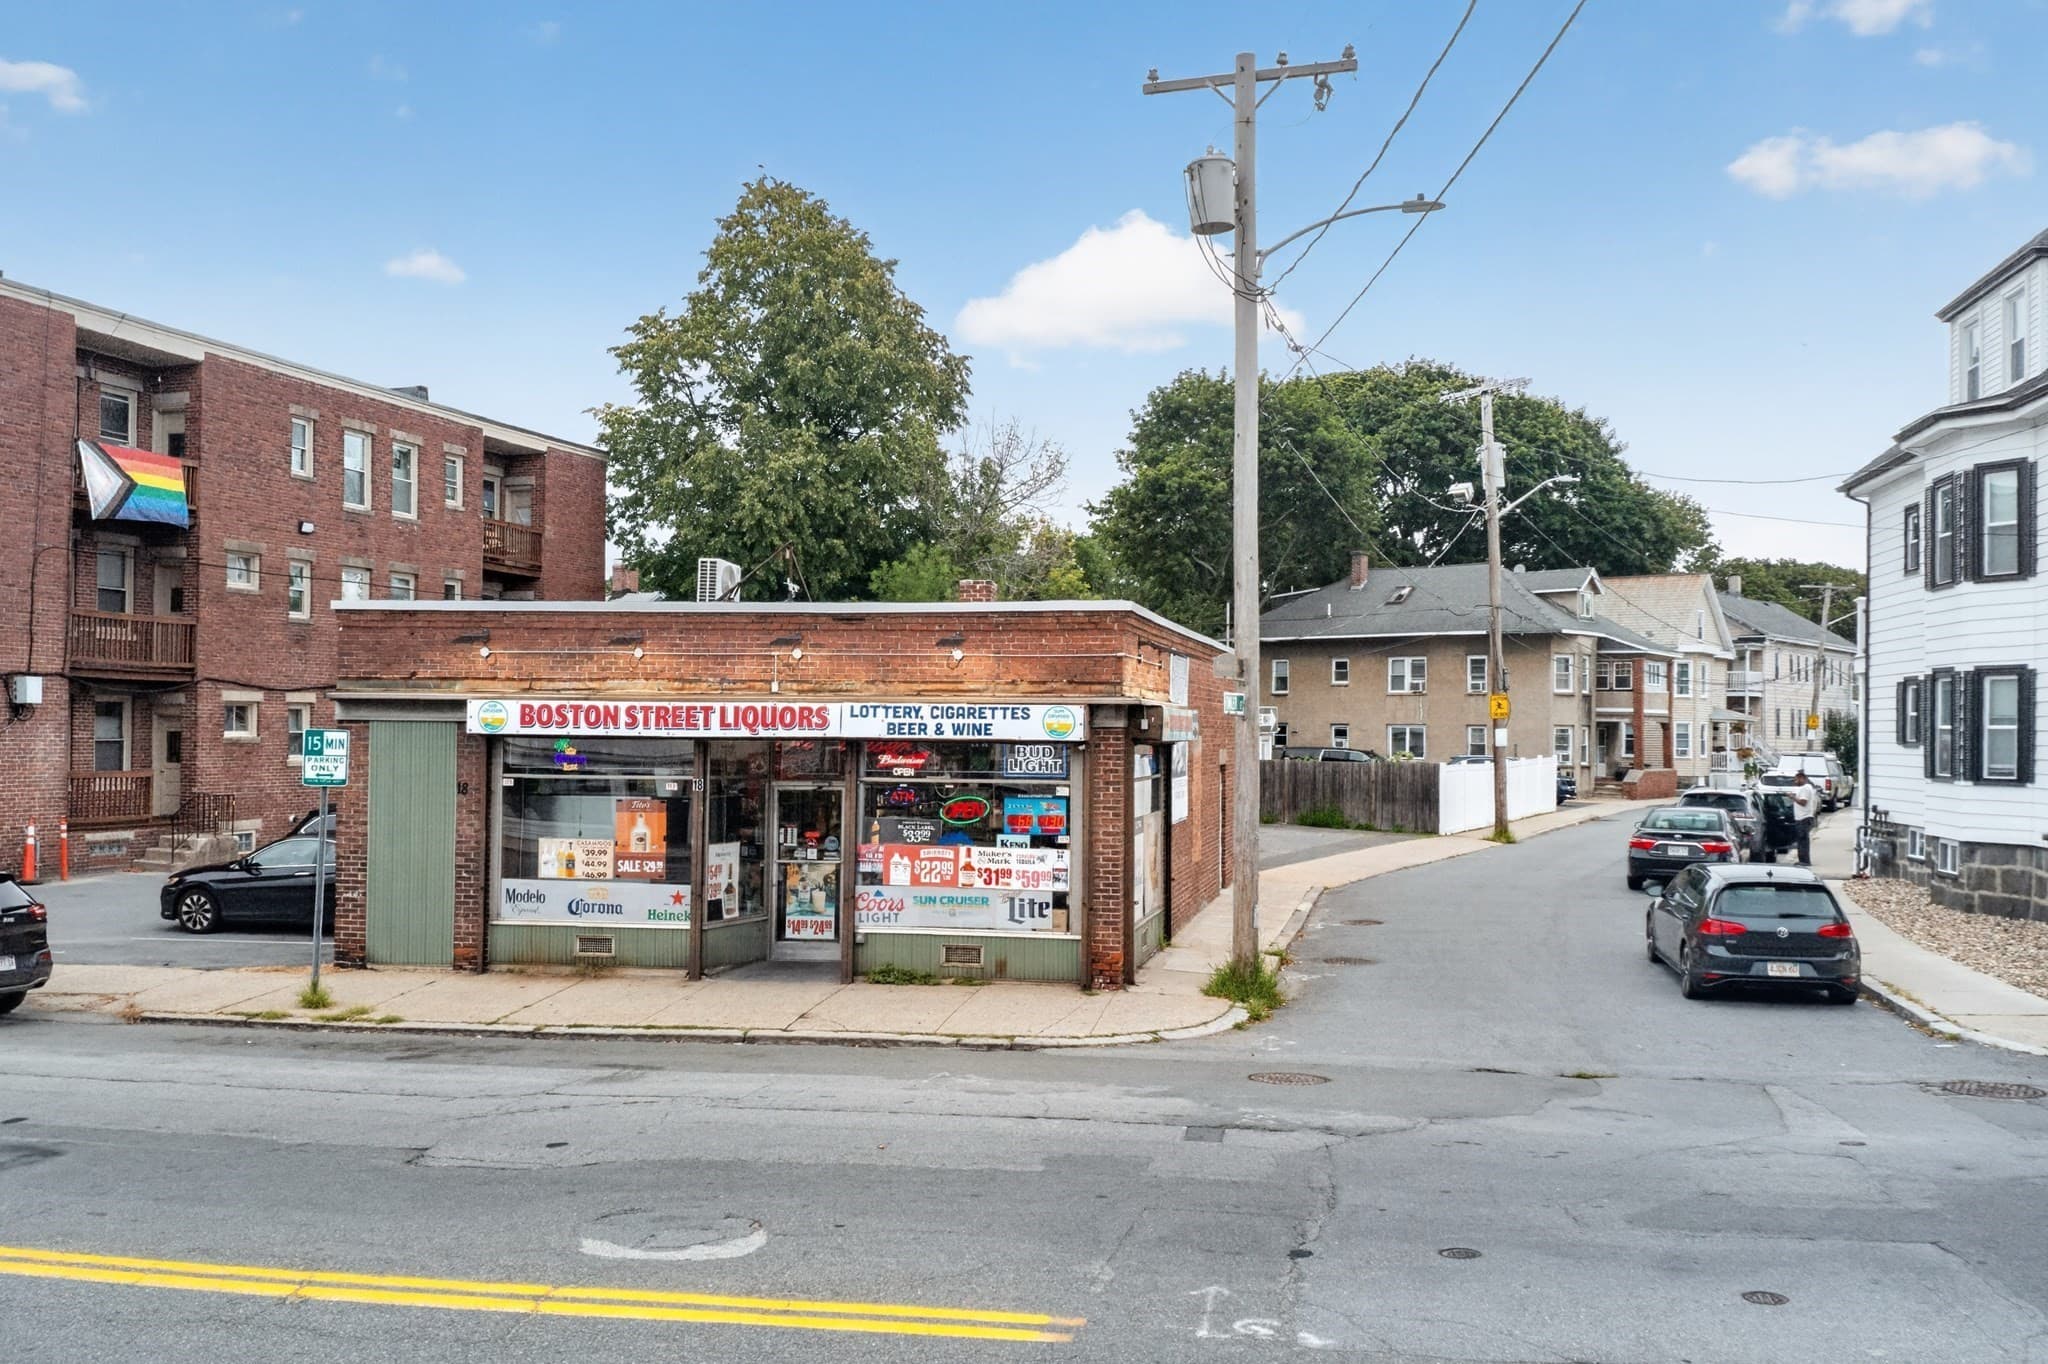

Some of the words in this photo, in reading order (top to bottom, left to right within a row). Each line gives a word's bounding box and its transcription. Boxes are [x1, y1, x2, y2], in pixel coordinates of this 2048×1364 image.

[519, 704, 620, 729] BOSTON
[625, 705, 716, 731] STREET
[719, 705, 830, 735] LIQUORS
[850, 705, 923, 720] LOTTERY,
[930, 706, 1031, 720] CIGARETTES
[886, 722, 928, 736] BEER
[934, 723, 945, 735] &
[951, 723, 993, 736] WINE
[308, 736, 321, 750] 15
[325, 738, 345, 750] MIN
[1015, 745, 1055, 759] BUD
[892, 767, 915, 777] OPEN
[1007, 759, 1063, 774] LIGHT
[457, 782, 469, 795] 18
[692, 778, 704, 791] 18
[890, 790, 915, 802] ATM
[631, 800, 652, 809] Tito's
[943, 801, 986, 819] OPEN
[978, 850, 1012, 858] Maker's
[987, 857, 1011, 865] Mark
[617, 860, 641, 872] SALE
[505, 888, 546, 904] Modelo
[855, 892, 905, 912] Coors
[912, 895, 937, 906] SUN
[939, 896, 990, 906] CRUISER
[567, 898, 623, 918] Corona
[1007, 896, 1050, 924] Lite
[858, 912, 900, 924] LIGHT
